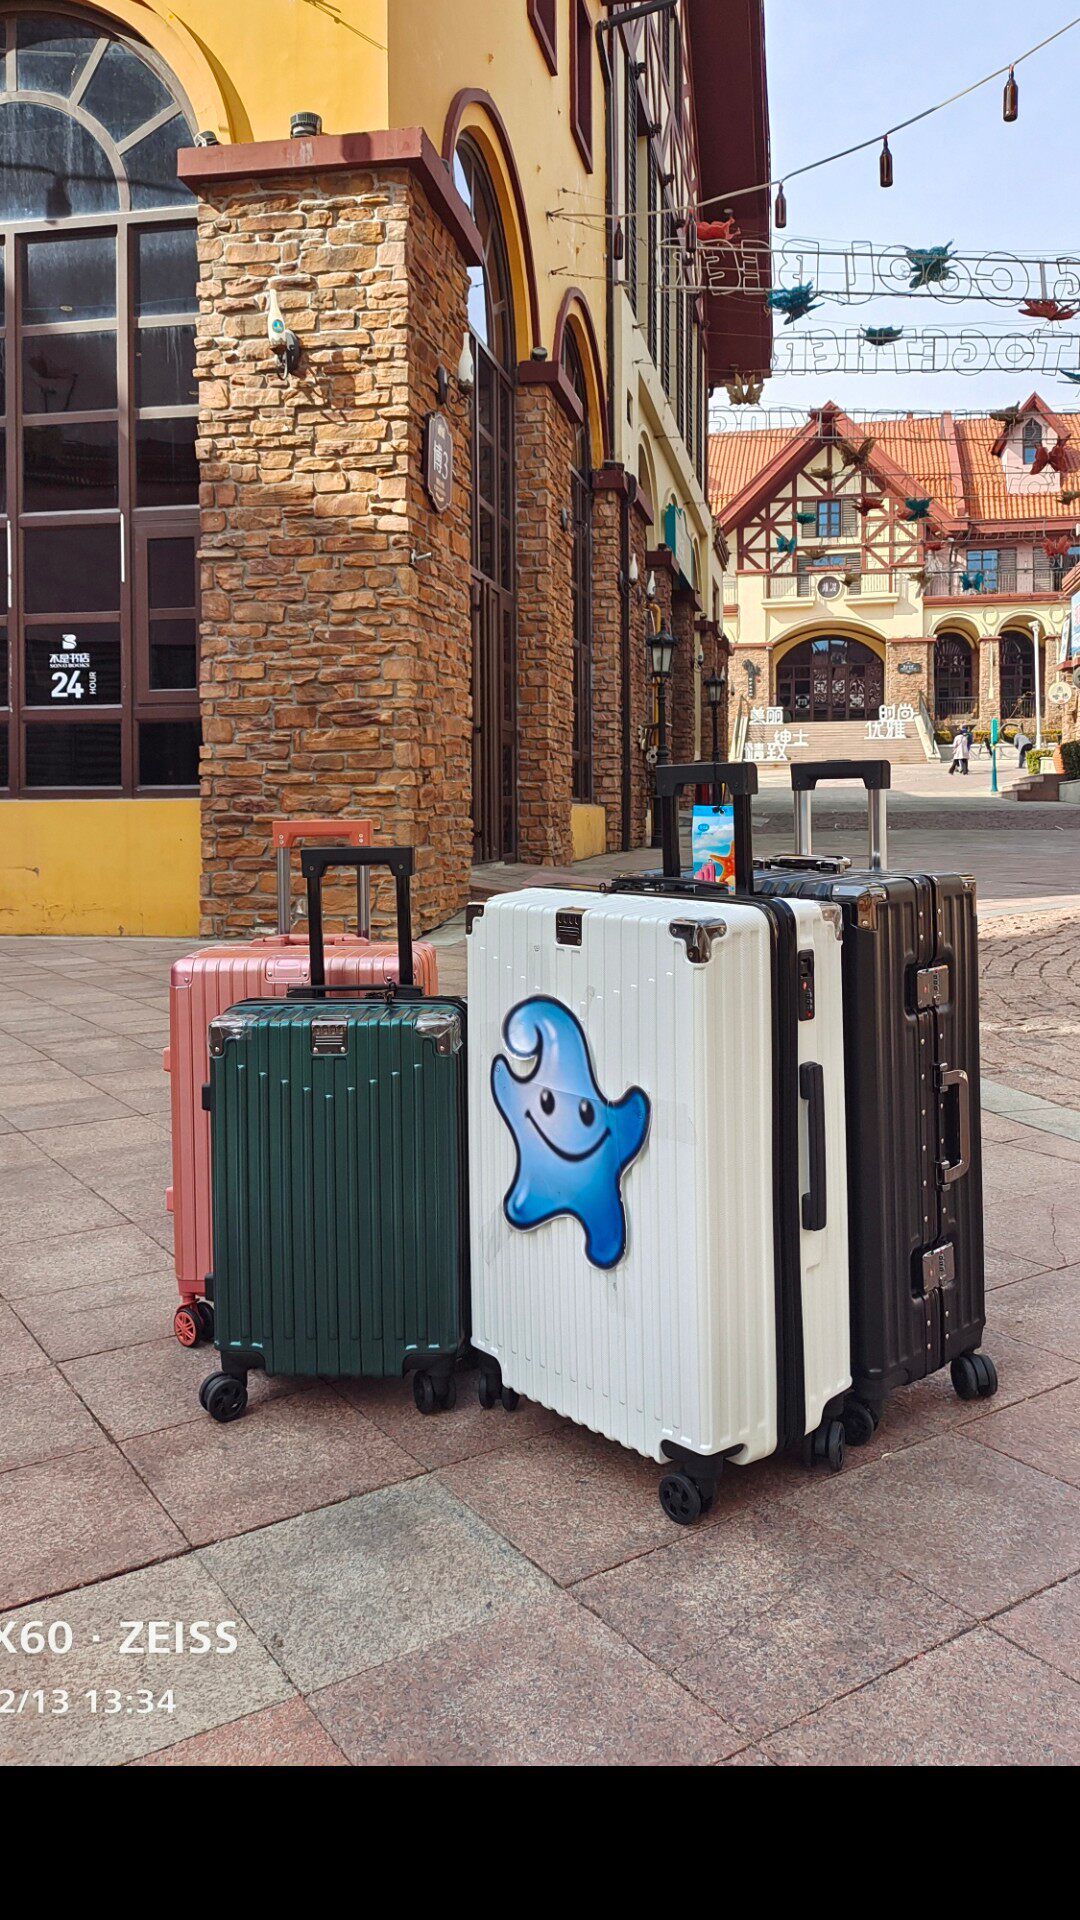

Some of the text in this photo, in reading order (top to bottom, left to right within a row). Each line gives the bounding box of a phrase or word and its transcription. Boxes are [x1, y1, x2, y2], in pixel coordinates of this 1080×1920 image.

[51, 670, 84, 698] 24
[89, 672, 97, 695] HOUR
[749, 706, 783, 724] 美丽
[878, 703, 915, 721] 时尚
[773, 728, 810, 746] 绅士
[864, 720, 906, 739] 优雅
